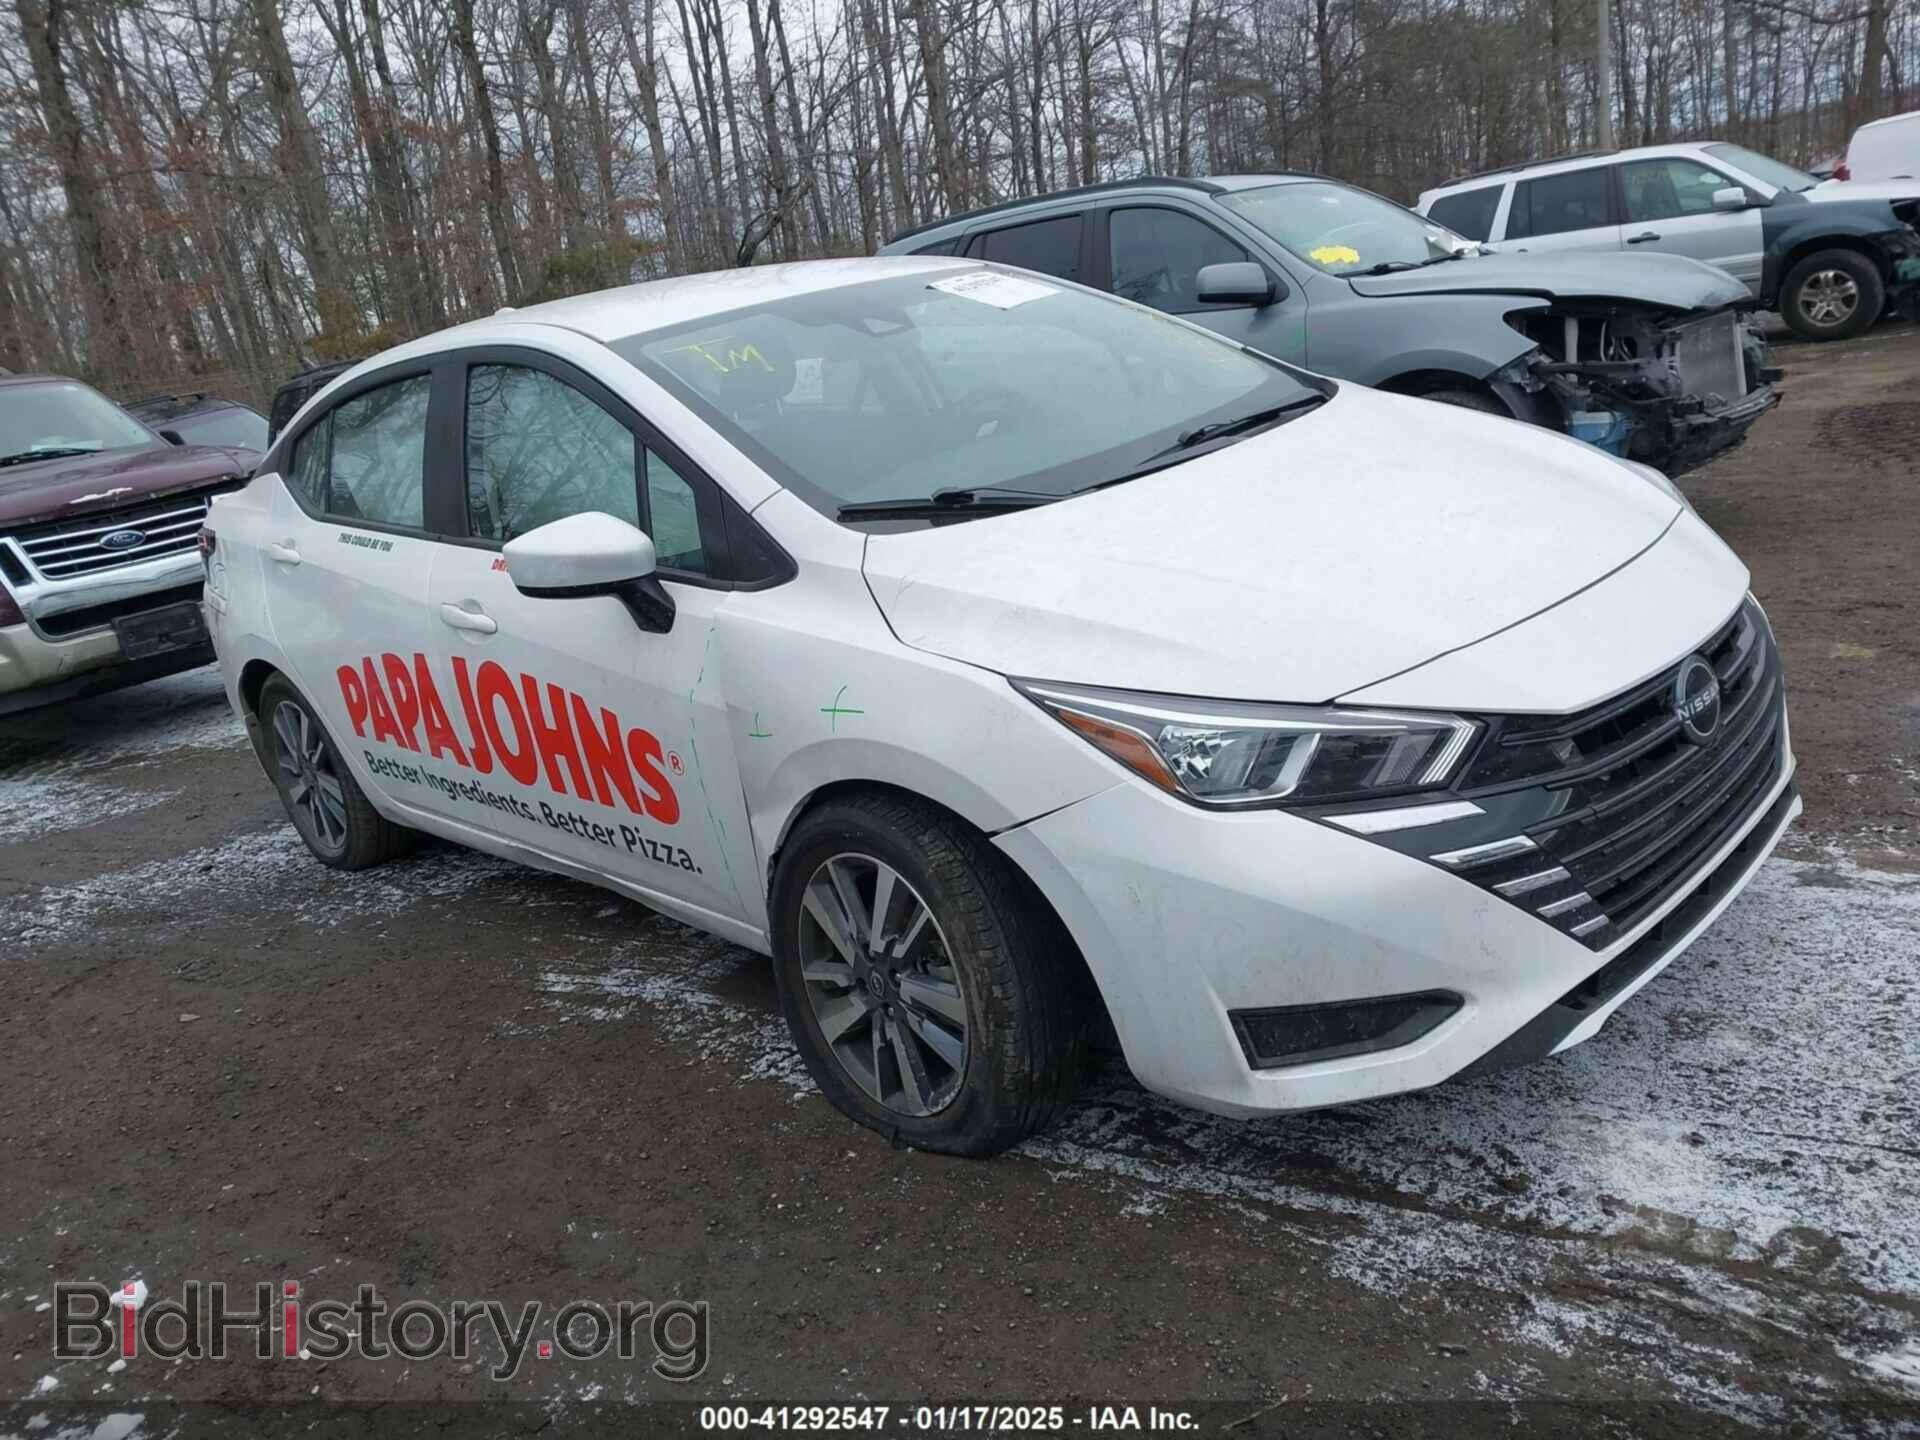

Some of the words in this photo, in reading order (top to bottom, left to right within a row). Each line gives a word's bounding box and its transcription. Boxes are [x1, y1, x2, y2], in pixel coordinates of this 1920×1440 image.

[338, 532, 352, 545] THIS
[351, 535, 371, 548] COULD
[379, 540, 394, 552] YOU
[336, 652, 471, 768] PAPA
[364, 750, 422, 786] Better
[420, 765, 541, 824] Ingredients.
[538, 801, 617, 848] Better
[619, 824, 703, 875] Pizza.
